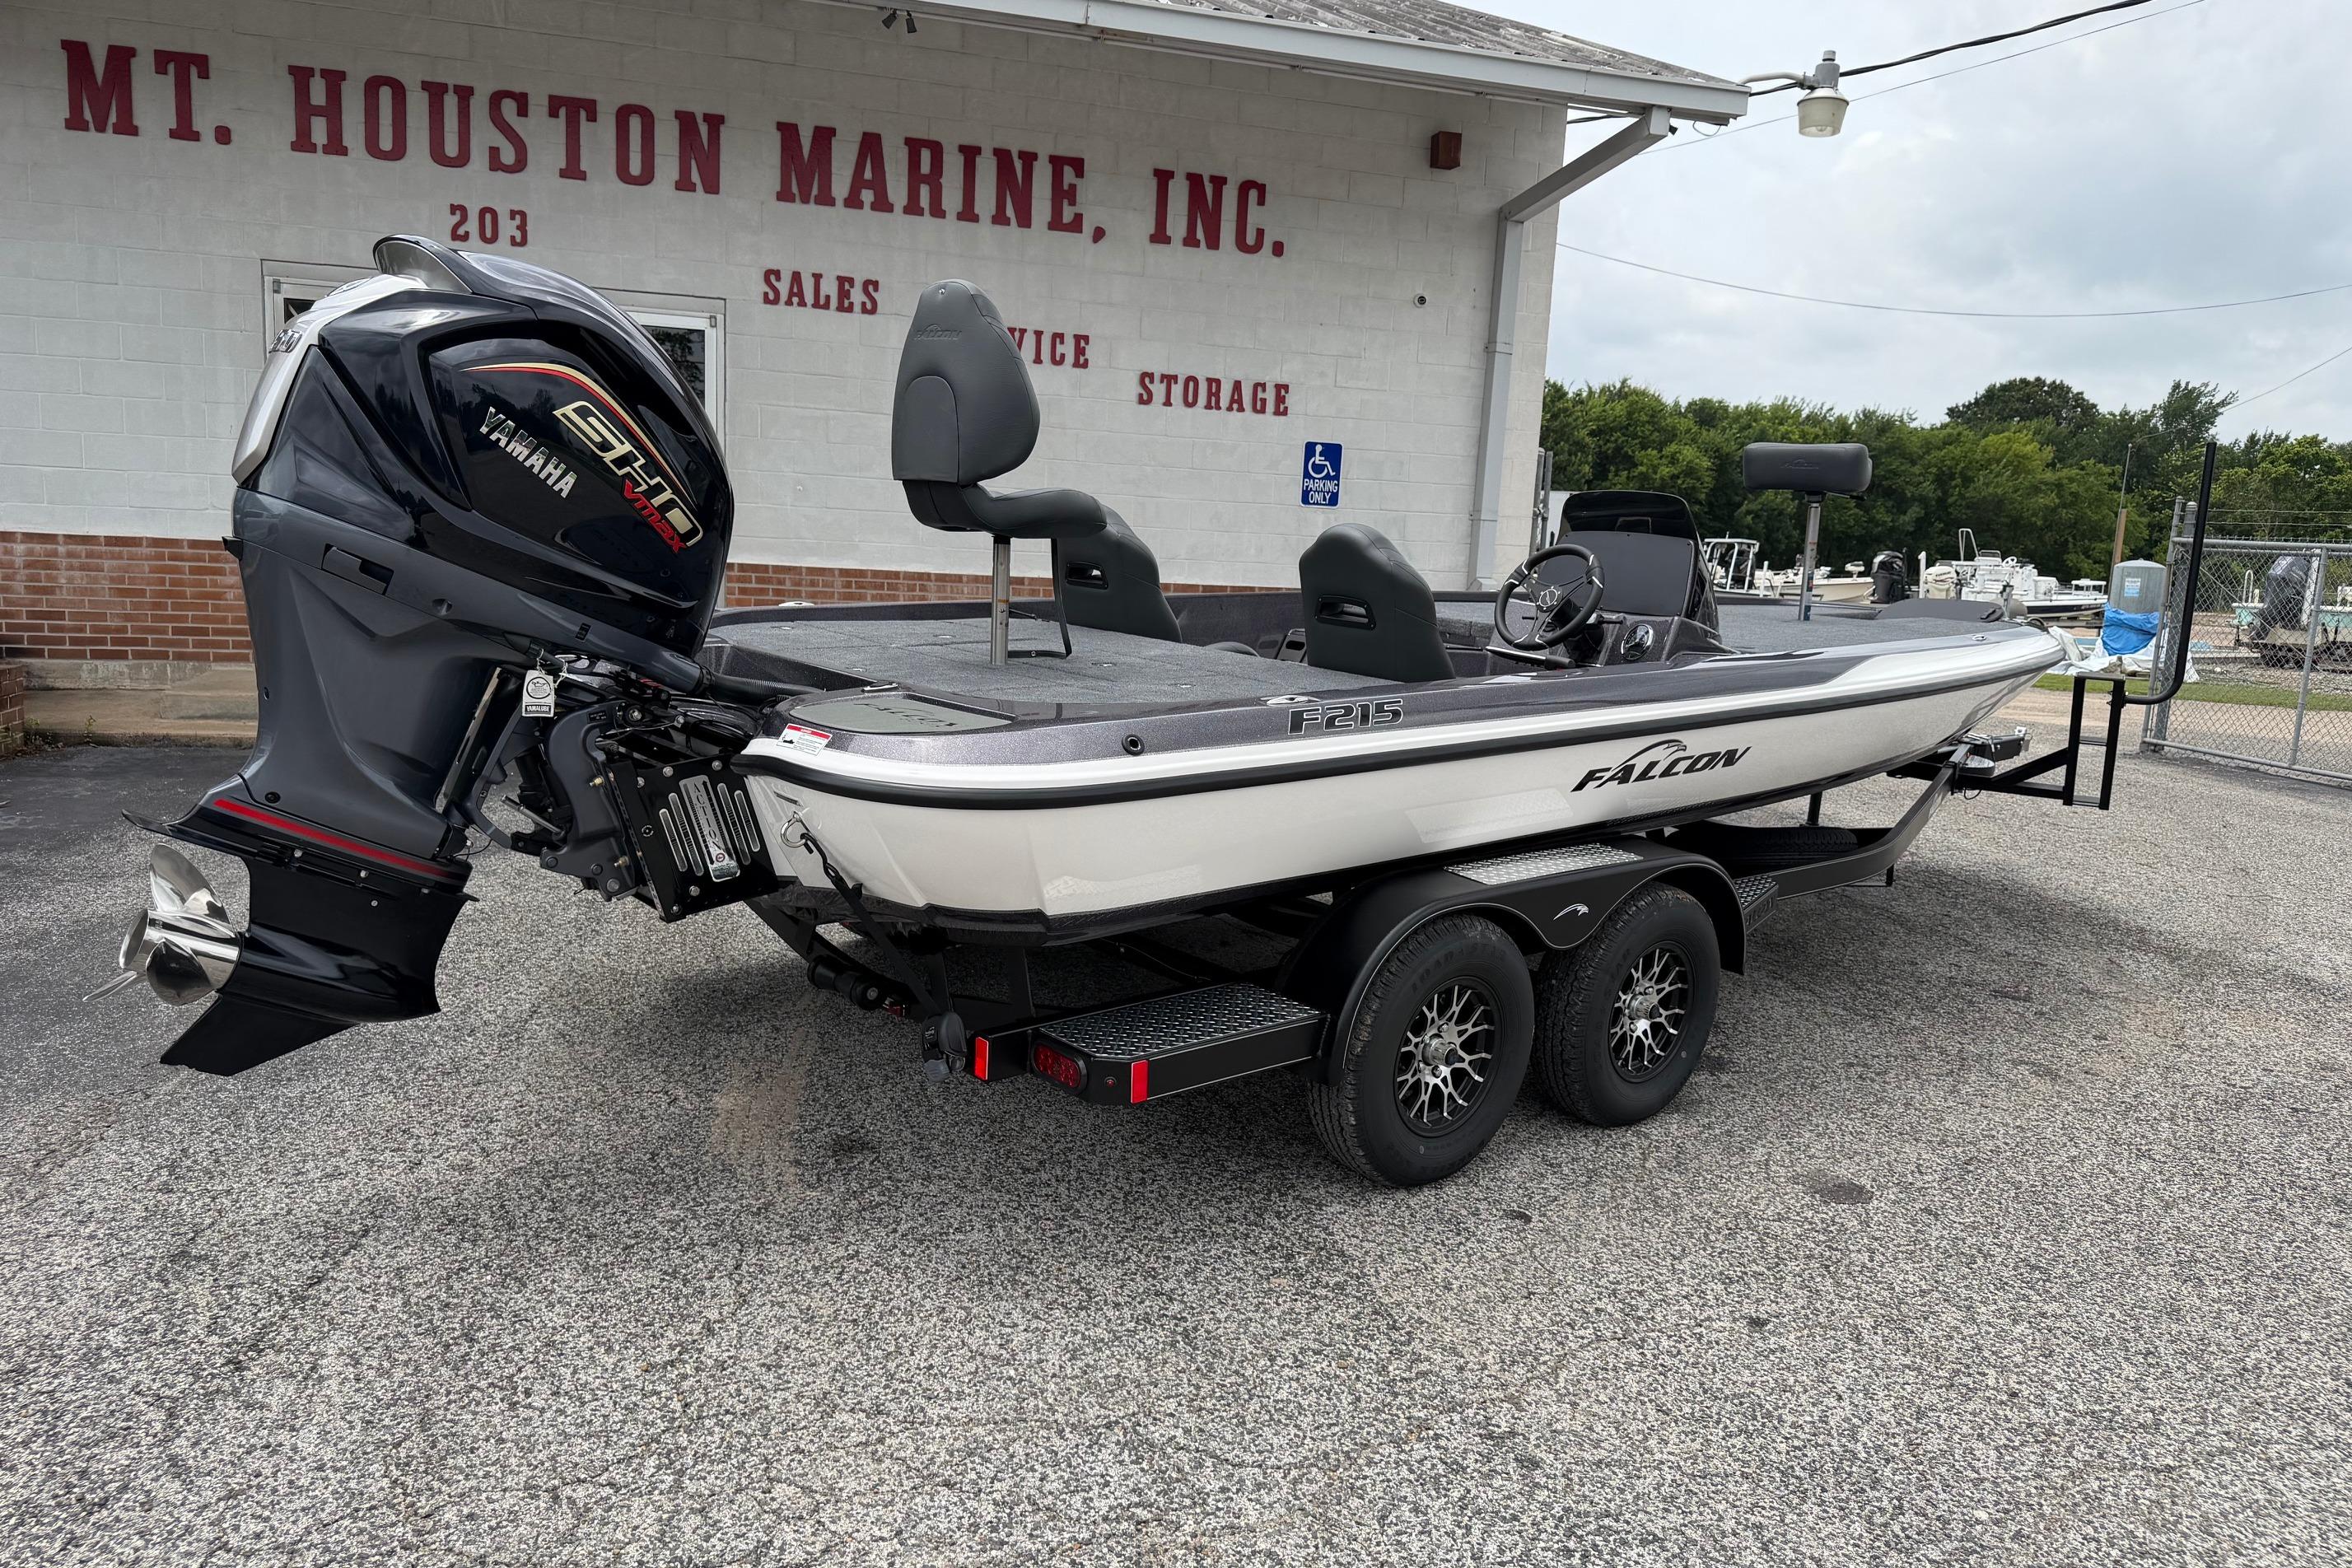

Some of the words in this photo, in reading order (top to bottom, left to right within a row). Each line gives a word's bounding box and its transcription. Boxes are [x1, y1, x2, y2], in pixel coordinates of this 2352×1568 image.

[61, 39, 232, 145] MT.
[287, 64, 726, 194] HOUSTON
[776, 121, 1106, 244] MARINE,
[1149, 167, 1286, 258] INC.
[449, 203, 529, 247] 203
[763, 268, 880, 315] SALES
[1138, 371, 1290, 417] STORAGE
[478, 406, 577, 499] YAMAHA
[552, 400, 704, 548] SHO
[1303, 478, 1338, 493] PARKING
[1309, 491, 1332, 505] ONLY
[1287, 698, 1403, 736] F215
[1570, 745, 1753, 793] FALCON
